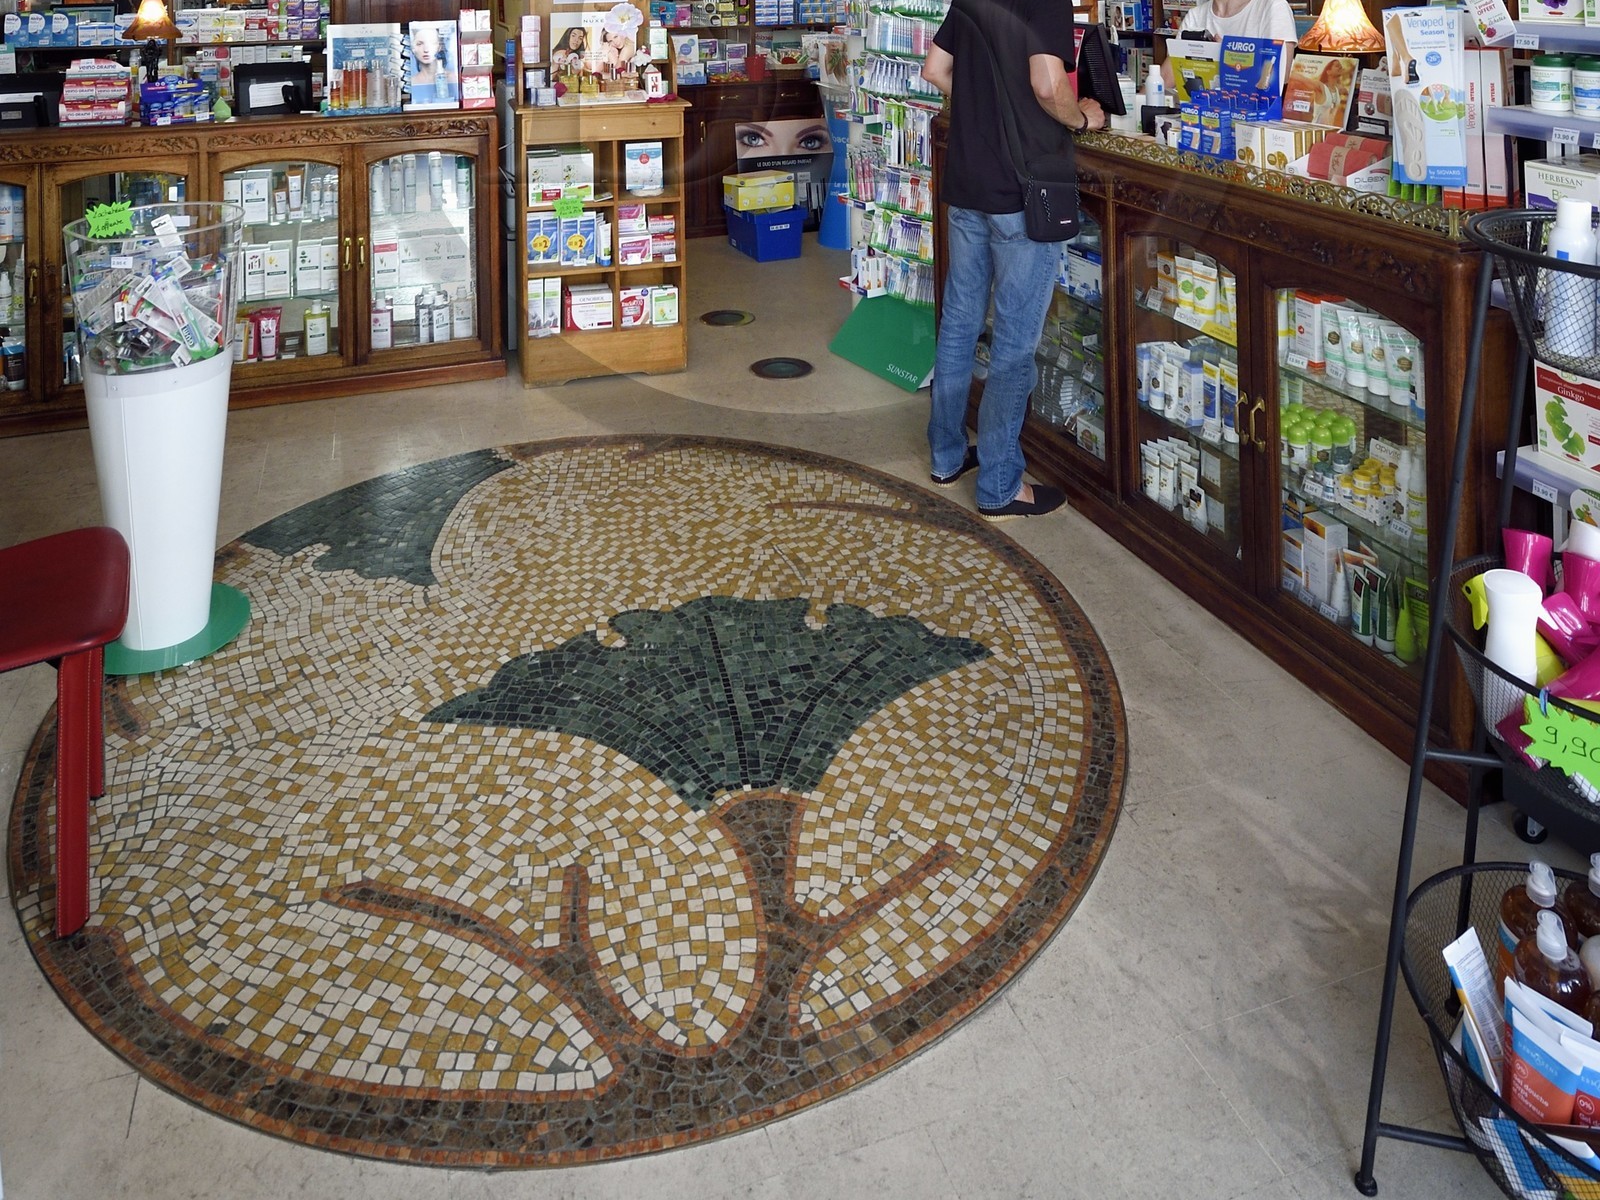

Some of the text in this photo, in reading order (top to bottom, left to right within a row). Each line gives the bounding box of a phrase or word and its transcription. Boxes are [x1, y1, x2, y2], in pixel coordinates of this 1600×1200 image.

[1476, 3, 1497, 16] OFFERT
[1406, 16, 1444, 29] Venoped
[1231, 41, 1256, 52] URGO
[1204, 111, 1219, 119] URGO
[1231, 112, 1246, 120] URGO
[1466, 103, 1476, 130] Venoped
[1537, 171, 1583, 187] HERBESAN
[886, 363, 919, 383] SUNSTAR
[1557, 386, 1585, 402] Ginkgo
[1515, 1062, 1527, 1075] 0%
[1513, 1073, 1549, 1107] Gel douche
[1517, 1091, 1545, 1119] cheveux
[1579, 1098, 1592, 1111] 0%
